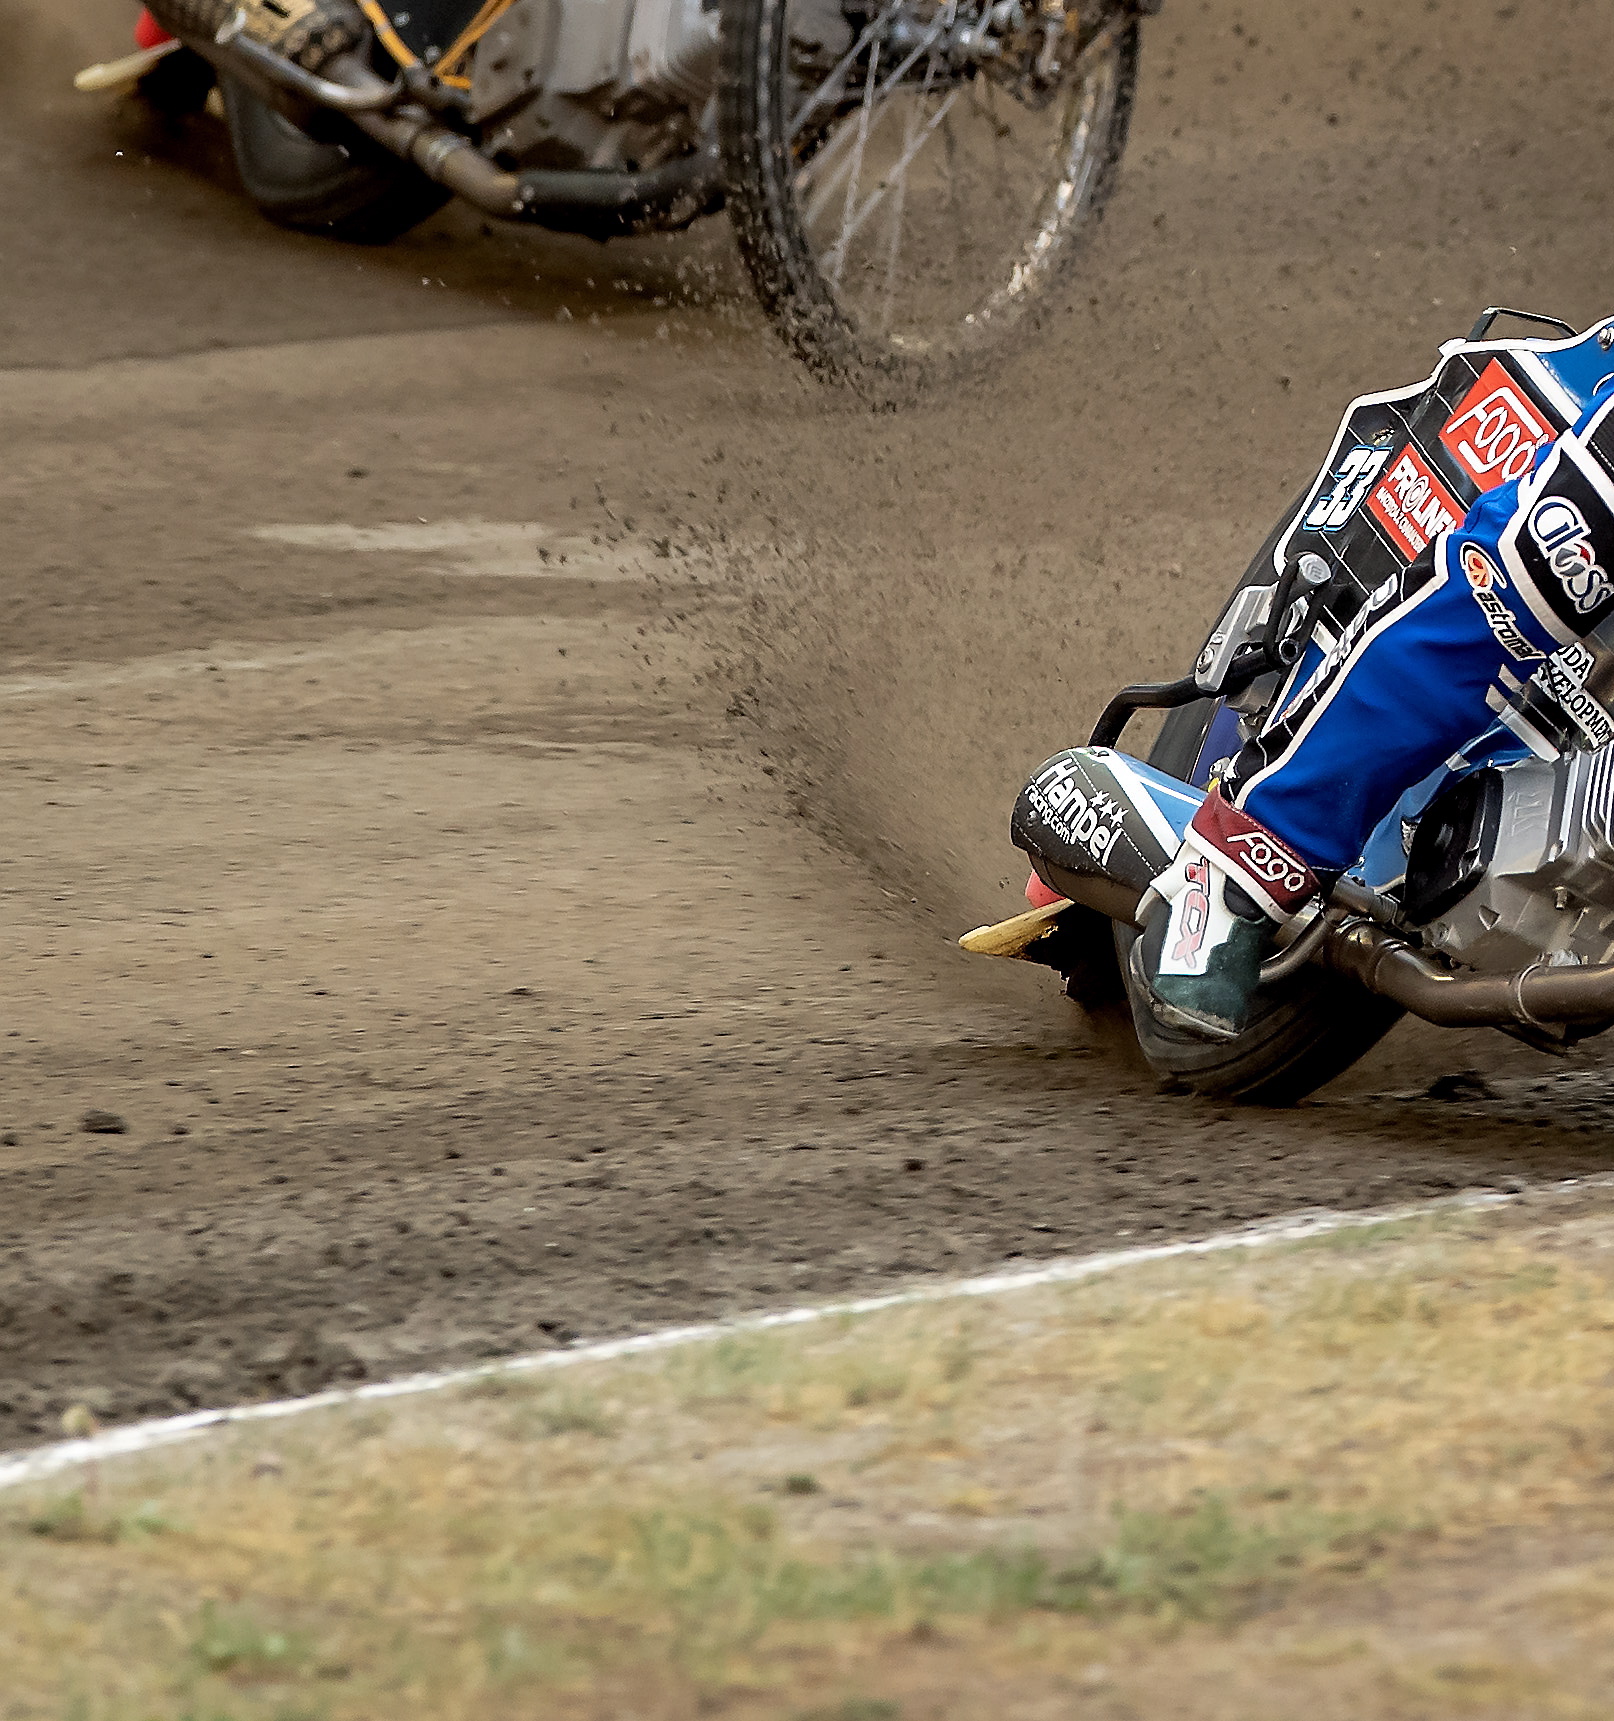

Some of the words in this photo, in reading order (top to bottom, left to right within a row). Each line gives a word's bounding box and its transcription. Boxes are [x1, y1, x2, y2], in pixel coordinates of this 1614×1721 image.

[1446, 386, 1544, 483] Fogo
[1302, 443, 1395, 532] 33
[1528, 494, 1614, 614] Gloss
[1024, 784, 1073, 845] racing.com
[1037, 757, 1123, 867] Hampel
[1227, 831, 1306, 892] Fogo
[1171, 856, 1210, 968] TCX
